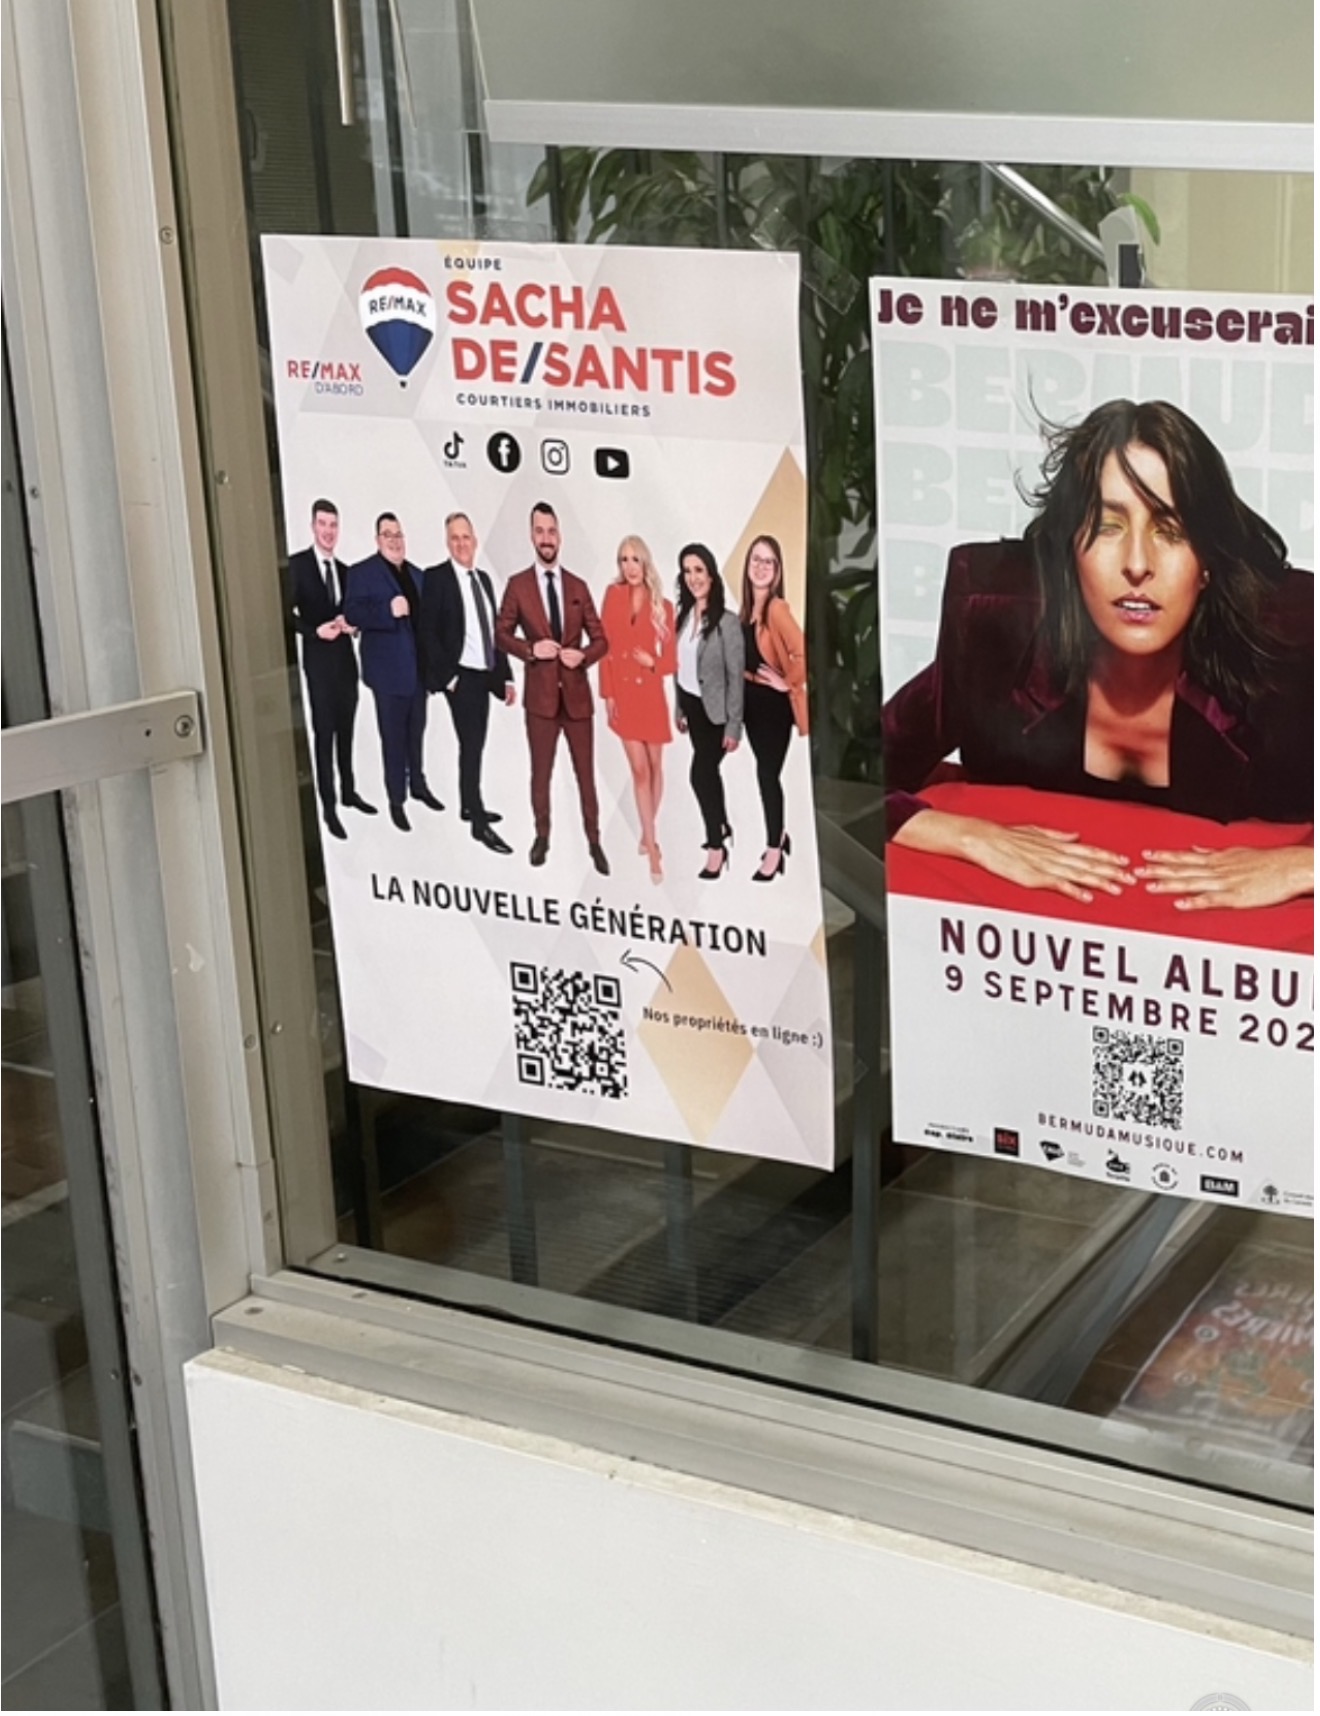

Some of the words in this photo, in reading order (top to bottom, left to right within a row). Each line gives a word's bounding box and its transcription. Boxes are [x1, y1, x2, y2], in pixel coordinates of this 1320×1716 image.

[443, 256, 503, 271] ÉQUIPE
[369, 296, 427, 318] RE/MAX
[446, 280, 627, 332] SACHA
[877, 288, 924, 325] Je
[940, 295, 998, 329] ne
[287, 360, 362, 382] RE/MAX
[452, 337, 737, 398] DE/SANTIS
[456, 392, 543, 411] COURTIERS
[548, 398, 651, 417] IMMOBILIERS
[371, 873, 405, 903] LA
[413, 880, 561, 927] NOUVELLE
[569, 896, 768, 957] GÉNÉRATION
[940, 917, 1139, 985] NOUVEL
[1163, 954, 1314, 1012] ALBU
[944, 965, 964, 993] 9
[984, 971, 1219, 1037] SEPTEMBRE
[643, 1006, 671, 1024] Nos
[673, 1008, 748, 1037] propriétés
[751, 1026, 770, 1040] en
[772, 1025, 809, 1047] ligne
[1038, 1112, 1245, 1164] BERMUDAMUSIQUE.COM
